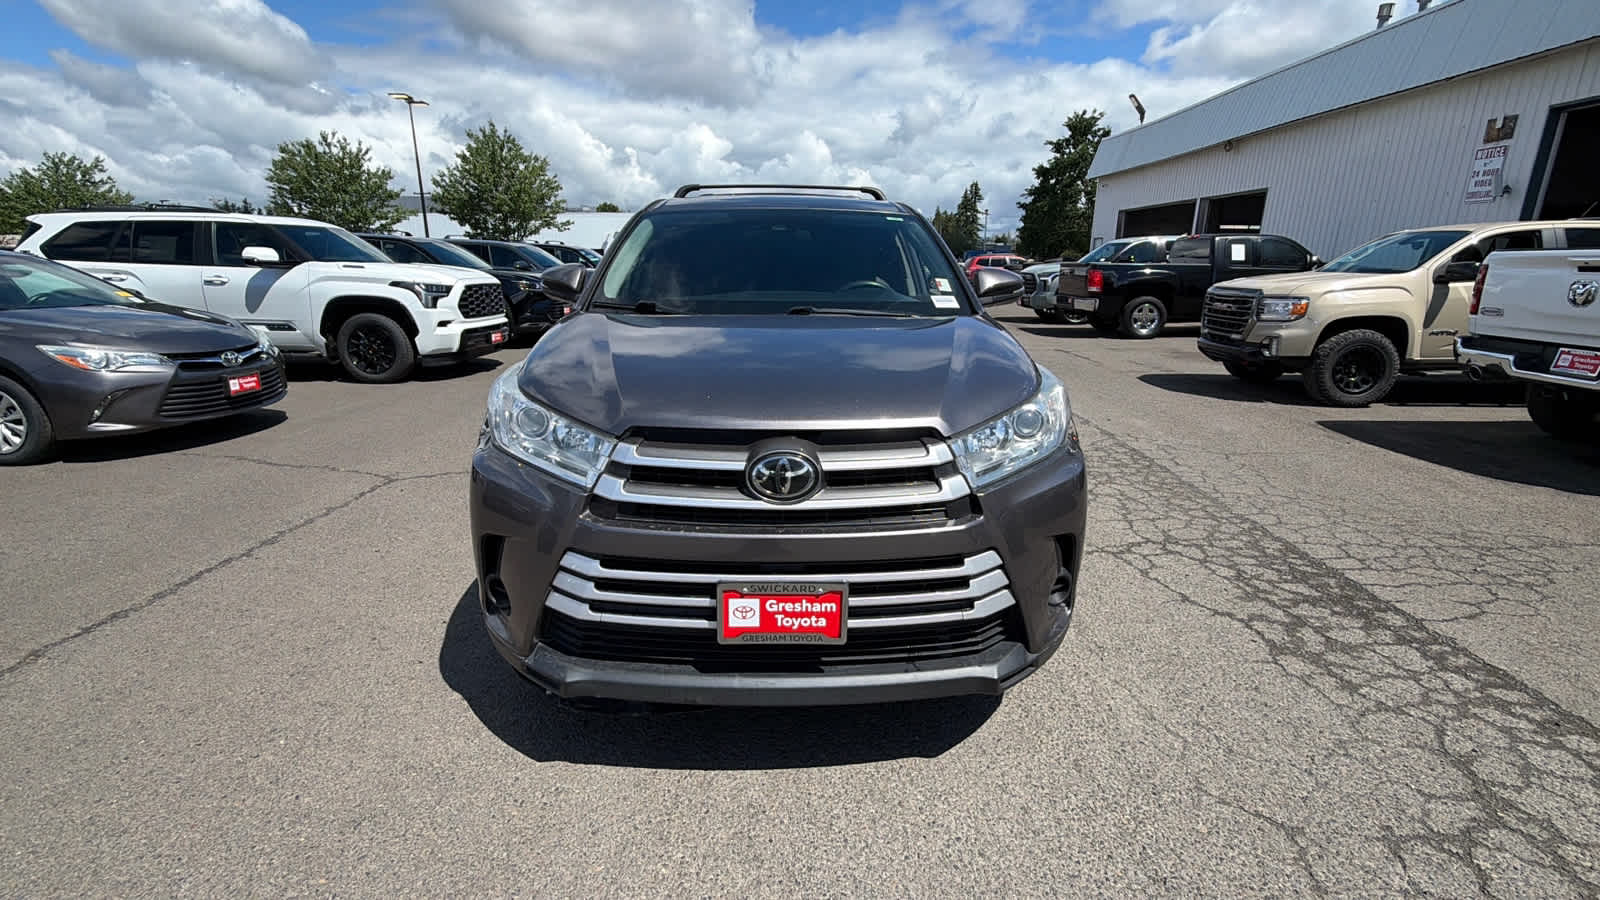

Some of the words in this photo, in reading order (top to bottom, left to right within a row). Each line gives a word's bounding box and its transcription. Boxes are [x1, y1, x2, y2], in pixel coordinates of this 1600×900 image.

[1477, 147, 1505, 159] NOTICE
[750, 584, 817, 593] SWICKARD
[765, 600, 837, 612] Gresham
[775, 614, 826, 629] Toyota
[742, 634, 786, 642] GRESHAM
[788, 634, 824, 642] TOYOTA
